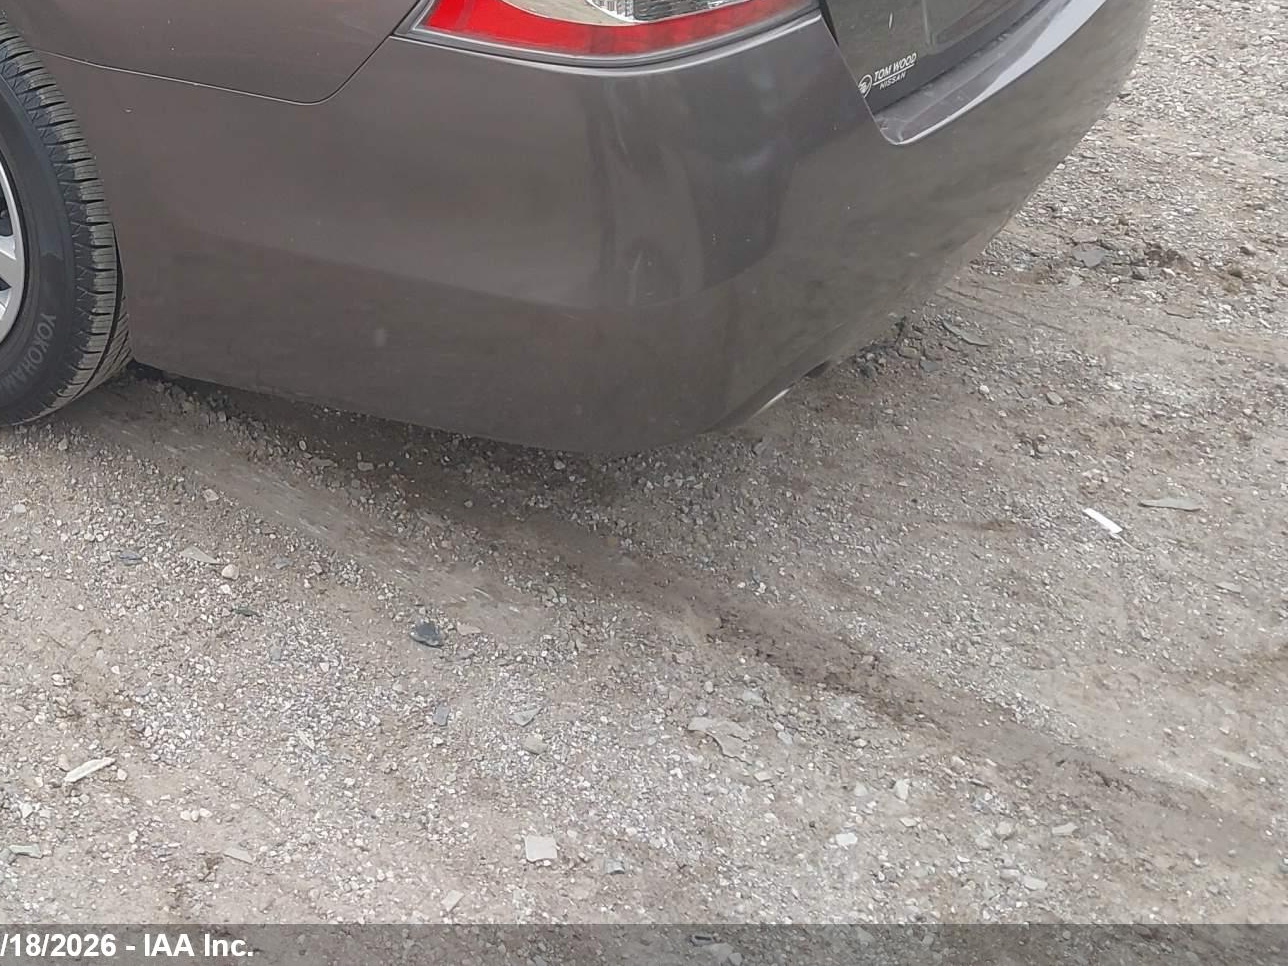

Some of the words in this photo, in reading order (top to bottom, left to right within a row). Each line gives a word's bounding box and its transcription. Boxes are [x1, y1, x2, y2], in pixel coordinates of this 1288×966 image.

[874, 64, 893, 83] TOM
[893, 52, 918, 73] WOOD
[879, 71, 907, 91] NISSAN
